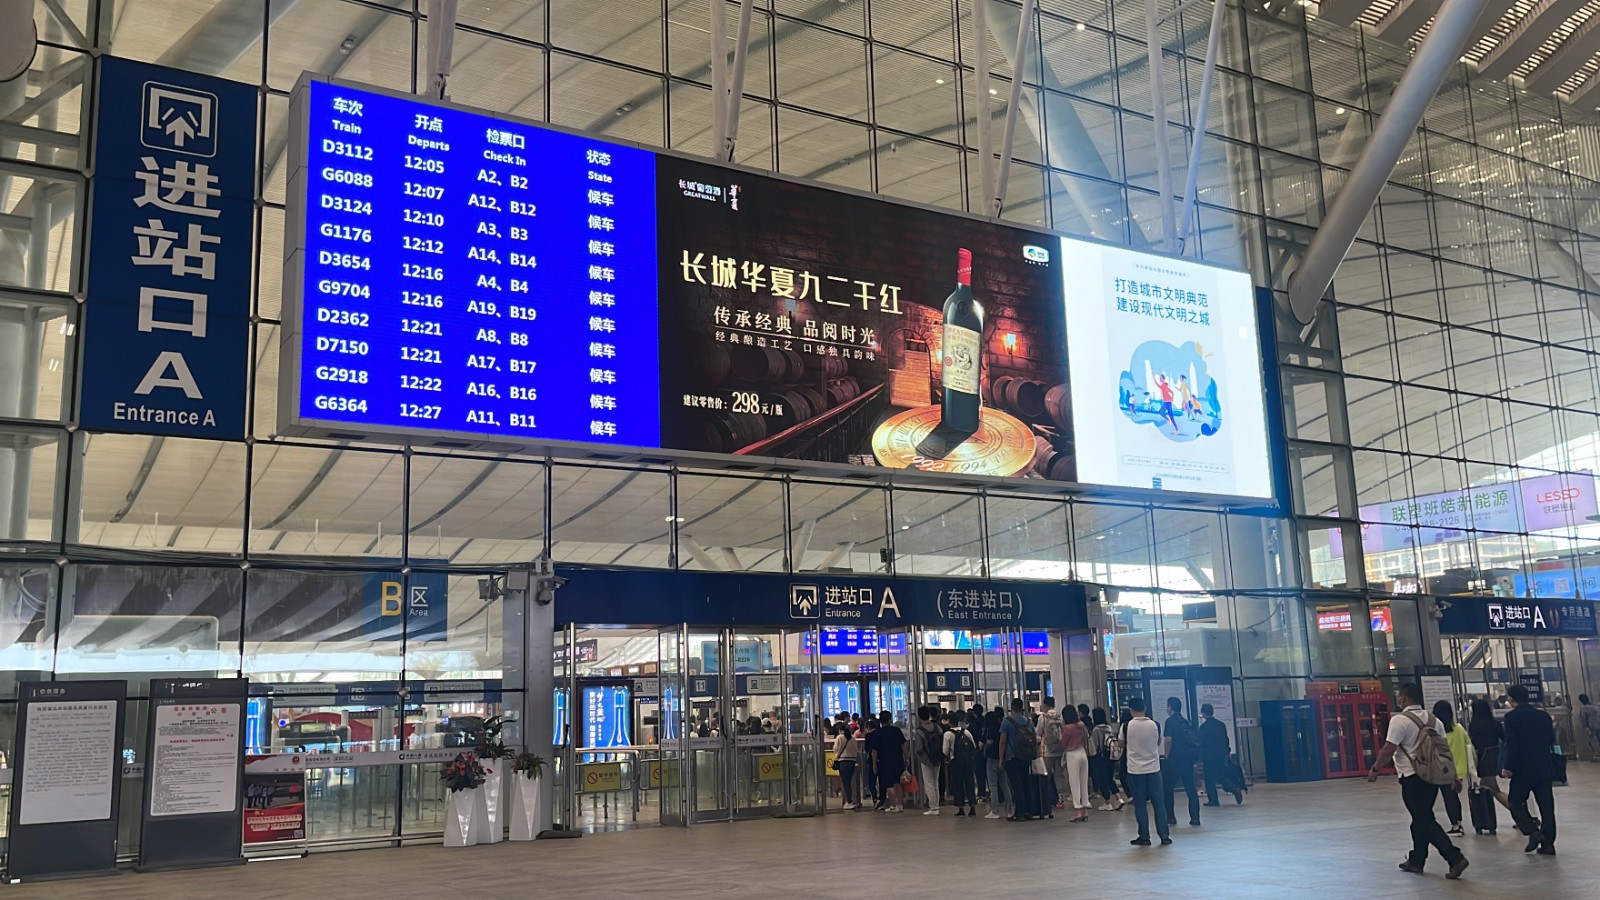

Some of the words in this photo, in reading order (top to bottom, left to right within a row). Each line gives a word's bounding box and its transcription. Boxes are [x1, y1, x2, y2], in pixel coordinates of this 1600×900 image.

[332, 120, 361, 134] Train
[408, 134, 450, 151] Departs
[484, 150, 514, 164] Check
[516, 156, 526, 166] In
[588, 171, 612, 183] State
[334, 97, 363, 116] 车次
[415, 114, 442, 132] 开点
[486, 128, 525, 149] 检票口
[587, 149, 611, 165] 状态
[322, 139, 373, 160] D3112
[404, 156, 444, 173] 12:05
[588, 189, 614, 206] 候车
[322, 168, 372, 187] G6088
[404, 182, 444, 199] 12:07
[588, 215, 614, 231] 候车
[321, 195, 372, 215] D3124
[403, 209, 444, 226] 12:10
[589, 240, 615, 256] 候车
[320, 224, 371, 243] G1176
[403, 237, 443, 254] 12:12
[589, 265, 615, 282] 候车
[319, 251, 370, 270] D3654
[402, 264, 443, 280] 12:16
[589, 291, 615, 307] 候车
[680, 249, 904, 315] 长城华夏九二干红
[1115, 276, 1209, 308] 打造城市文明典范
[318, 280, 370, 298] G9704
[402, 292, 443, 308] 12:16
[589, 316, 615, 333] 候车
[714, 305, 793, 335] 传承经典
[803, 319, 876, 346] 品阅时光
[1116, 296, 1211, 327] 建设现代文明之城
[317, 308, 368, 327] D2362
[401, 319, 442, 336] 12:21
[589, 342, 616, 358] 候车
[715, 330, 794, 351] 经典酿造工艺
[803, 343, 876, 362] 口感独具韵味
[316, 337, 368, 355] D7150
[401, 347, 442, 363] 12:21
[590, 368, 616, 384] 候车
[315, 366, 368, 384] G2918
[400, 375, 441, 391] 12:22
[590, 394, 616, 410] 候车
[113, 402, 199, 426] Entrance
[202, 409, 217, 427] A
[314, 396, 367, 413] G6364
[399, 403, 441, 419] 12:27
[590, 420, 616, 436] 候车
[1392, 489, 1510, 522] 联塑班皓新能源
[1536, 488, 1581, 504] LESSO
[382, 581, 402, 616] B
[411, 586, 428, 607] 区
[825, 585, 873, 606] 进站口
[877, 586, 901, 618] A
[825, 608, 861, 618] Entrance
[948, 610, 968, 619] East
[972, 611, 1012, 620] Entrance
[1505, 605, 1531, 619] 进站口
[1533, 605, 1547, 629] A
